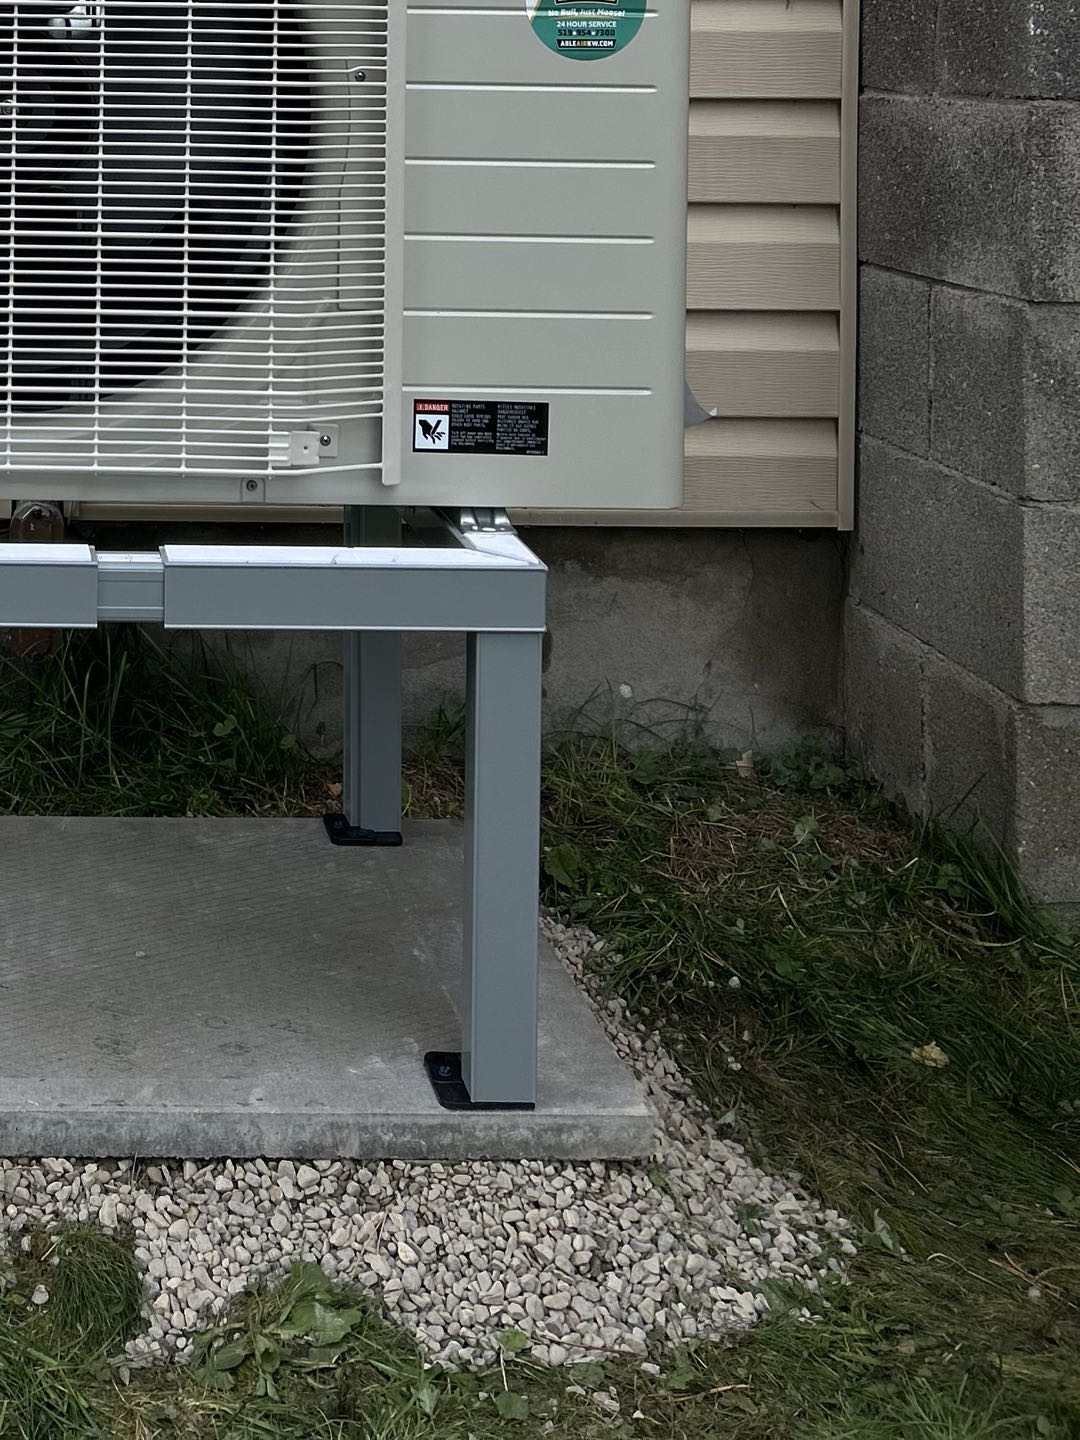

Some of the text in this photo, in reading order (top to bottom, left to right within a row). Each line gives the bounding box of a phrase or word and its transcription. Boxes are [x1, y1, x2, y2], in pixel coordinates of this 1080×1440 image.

[548, 9, 559, 17] No
[596, 8, 626, 17] Moose!
[425, 404, 449, 412] DANGER
